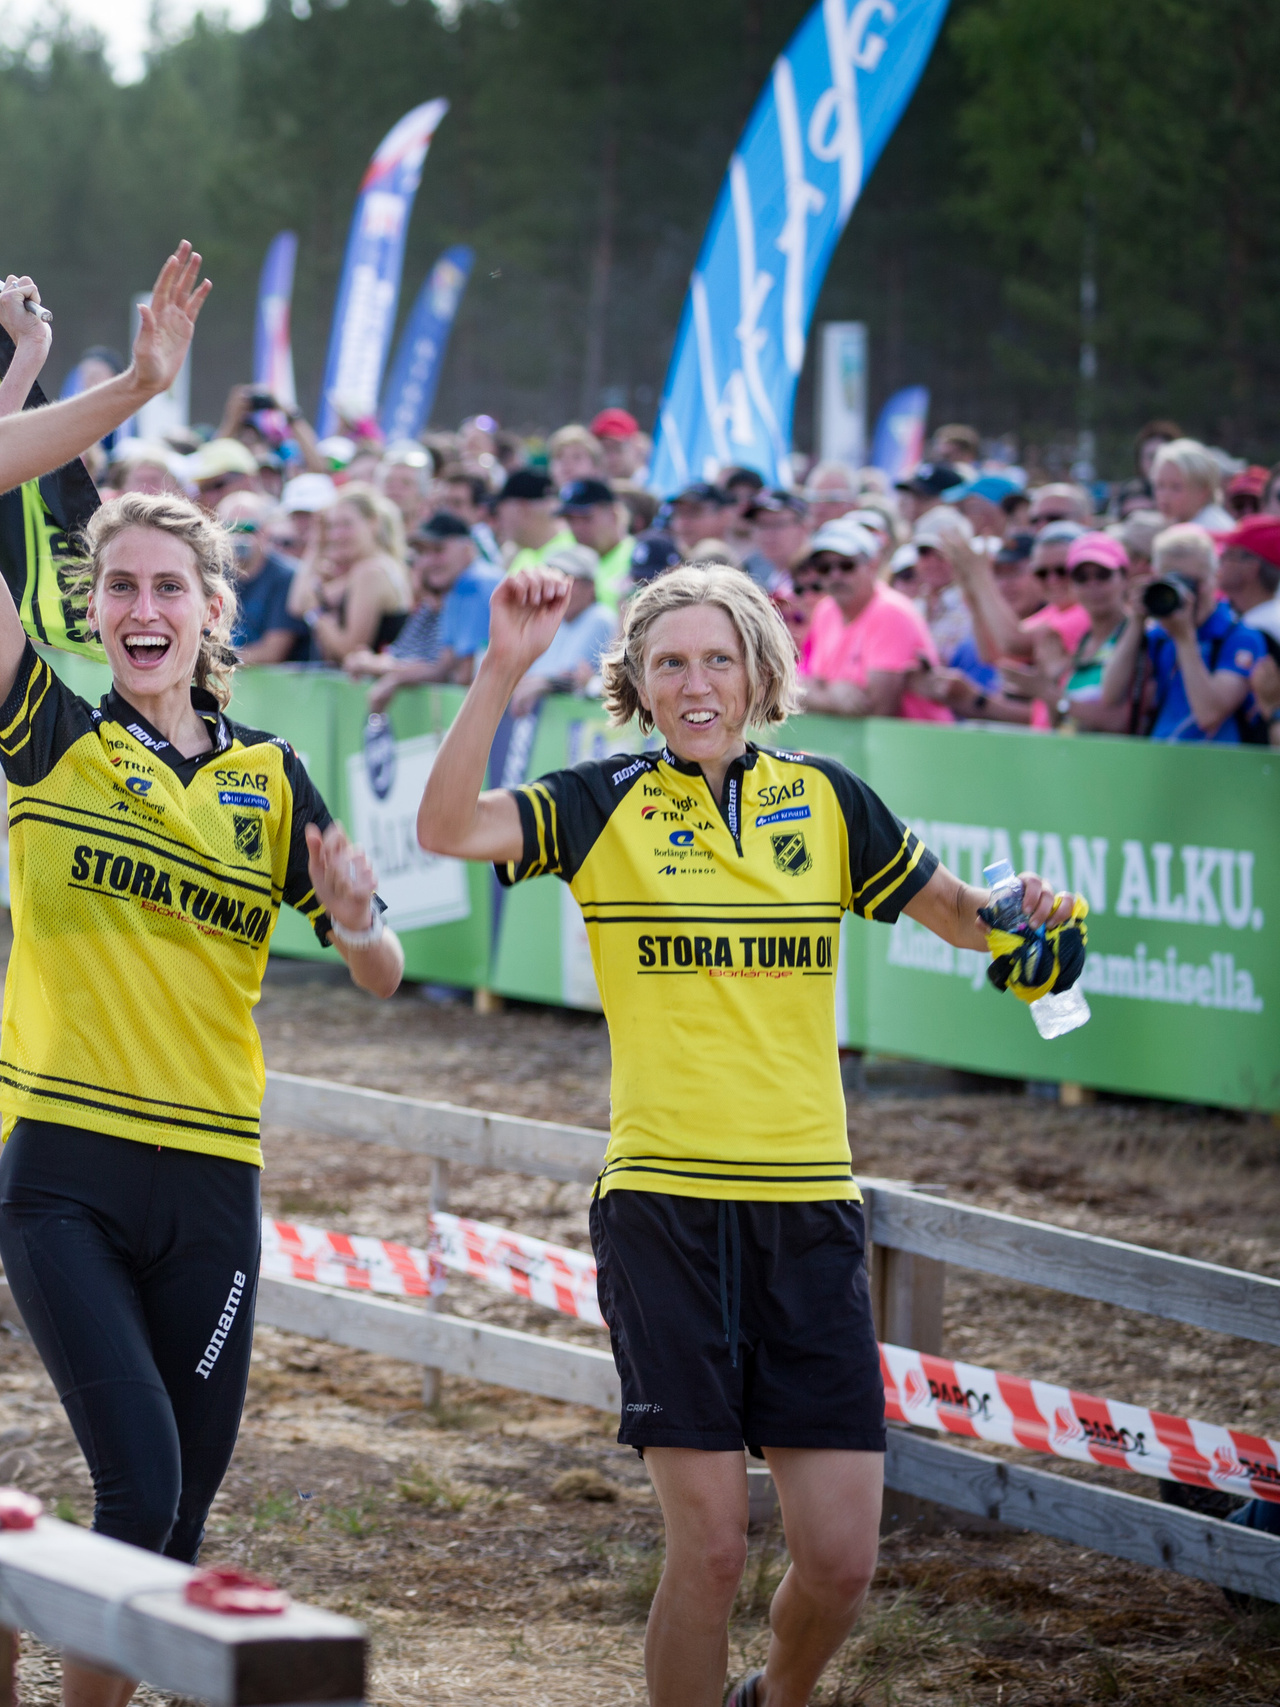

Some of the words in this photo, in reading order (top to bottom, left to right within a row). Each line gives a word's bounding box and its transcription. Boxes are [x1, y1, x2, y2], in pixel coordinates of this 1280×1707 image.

[214, 769, 268, 793] SSAB
[757, 778, 805, 807] SSAB
[653, 848, 688, 860] Borlänge
[71, 844, 173, 907] STORA
[1116, 838, 1264, 932] ALKU.
[638, 935, 734, 968] STORA
[738, 936, 811, 968] TUNA
[708, 968, 794, 979] Borlänge
[194, 1269, 247, 1380] noname
[626, 1403, 653, 1413] CRAFT
